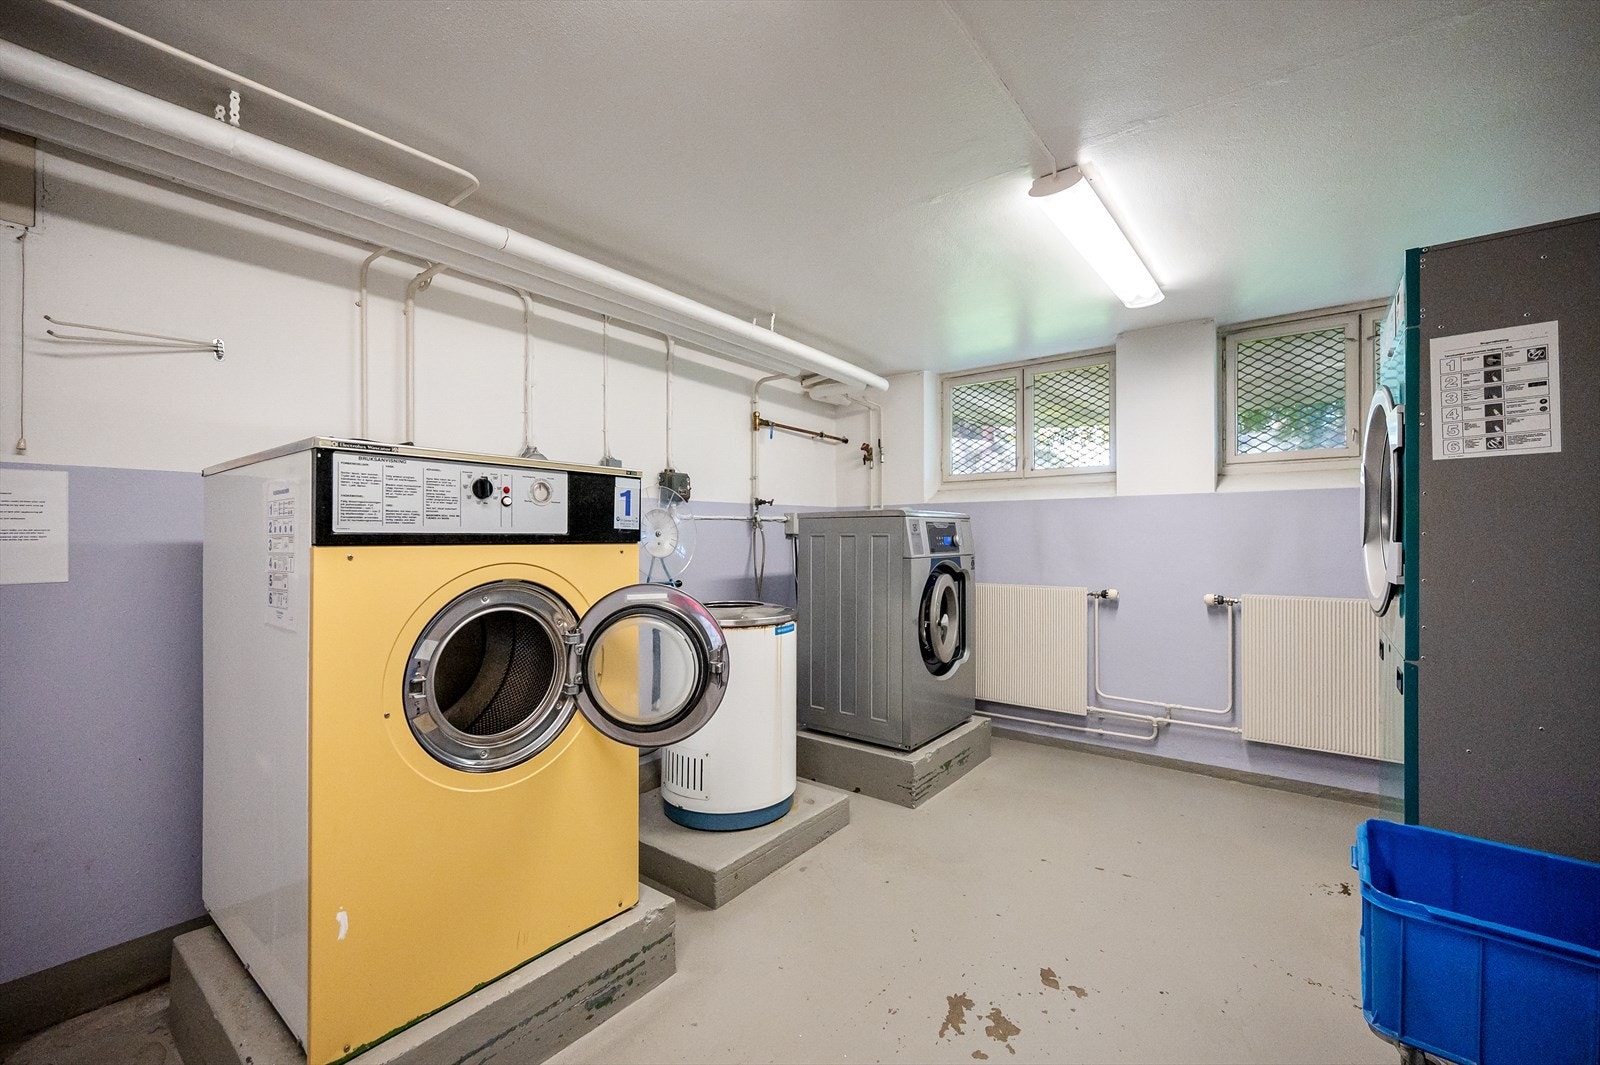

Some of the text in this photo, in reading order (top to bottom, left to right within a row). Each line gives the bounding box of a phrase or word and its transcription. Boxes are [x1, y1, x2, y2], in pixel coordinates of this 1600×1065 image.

[1446, 360, 1455, 371] 1
[1445, 375, 1458, 389] 2
[1445, 391, 1458, 404] 3
[1445, 408, 1459, 420] 4
[1446, 424, 1460, 437] 5
[340, 442, 366, 450] Electrolux
[1446, 441, 1460, 453] 6
[358, 455, 407, 465] BRUKSANVISNING
[620, 489, 632, 516] 1
